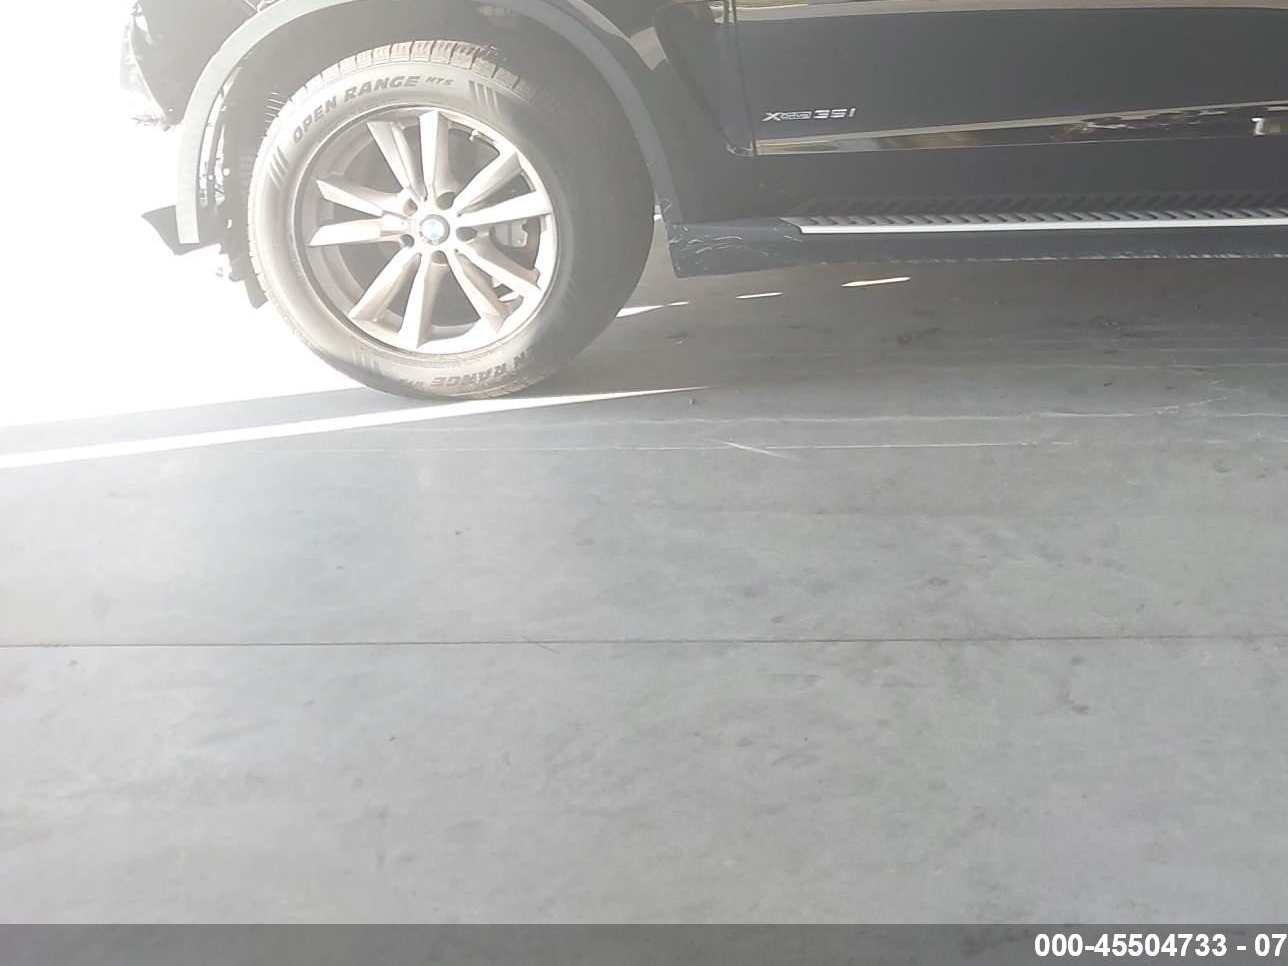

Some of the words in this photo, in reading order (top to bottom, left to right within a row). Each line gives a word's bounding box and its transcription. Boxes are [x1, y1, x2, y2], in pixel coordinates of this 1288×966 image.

[291, 95, 337, 144] OPEN
[343, 75, 420, 103] RANGE
[431, 362, 507, 387] RANGE
